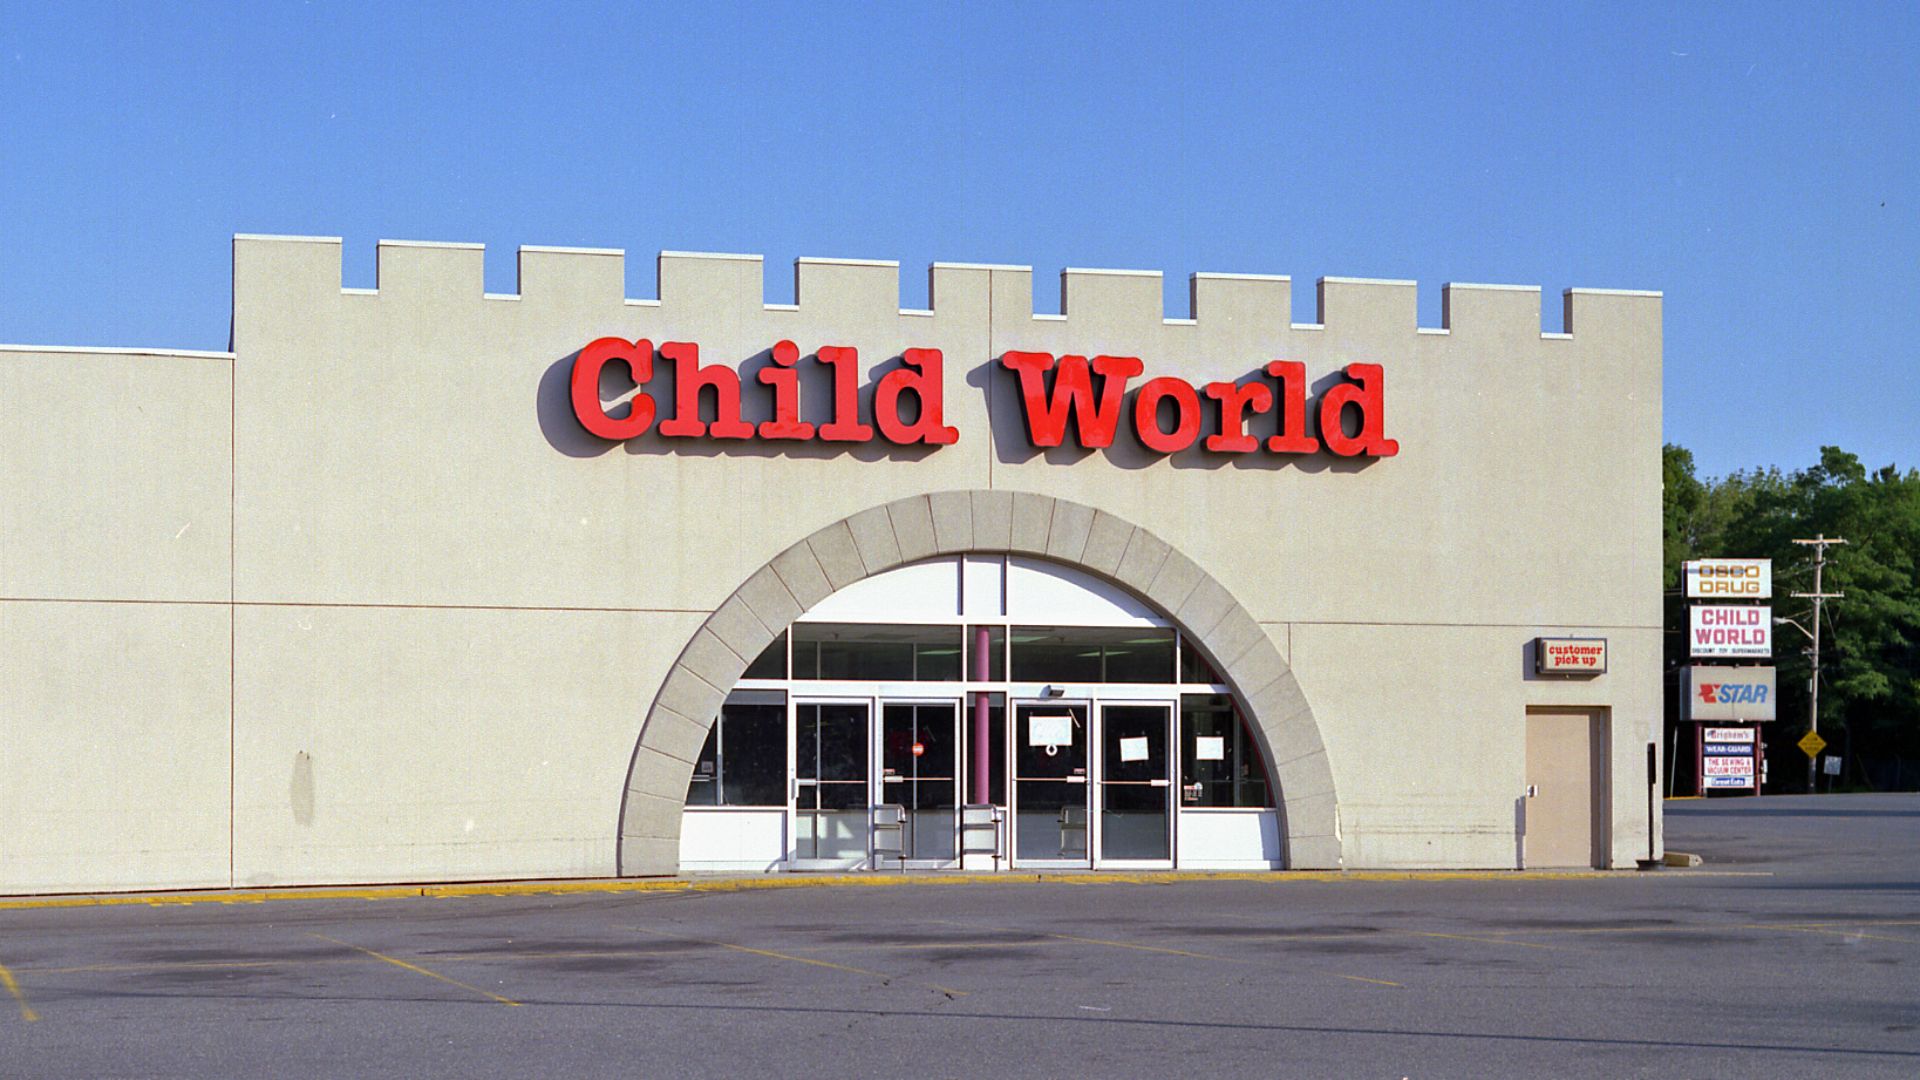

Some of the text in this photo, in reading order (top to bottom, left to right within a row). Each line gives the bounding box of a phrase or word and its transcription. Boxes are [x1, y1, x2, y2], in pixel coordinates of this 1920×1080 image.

[571, 336, 1400, 457] Child World
[1699, 565, 1760, 578] OSCO
[1699, 581, 1760, 593] DRUG
[1701, 609, 1760, 626] CHILD
[1695, 628, 1766, 645] WORLD
[1549, 645, 1603, 655] customer
[1555, 656, 1597, 666] pick up
[1718, 684, 1769, 703] STAR
[1708, 758, 1719, 766] THE
